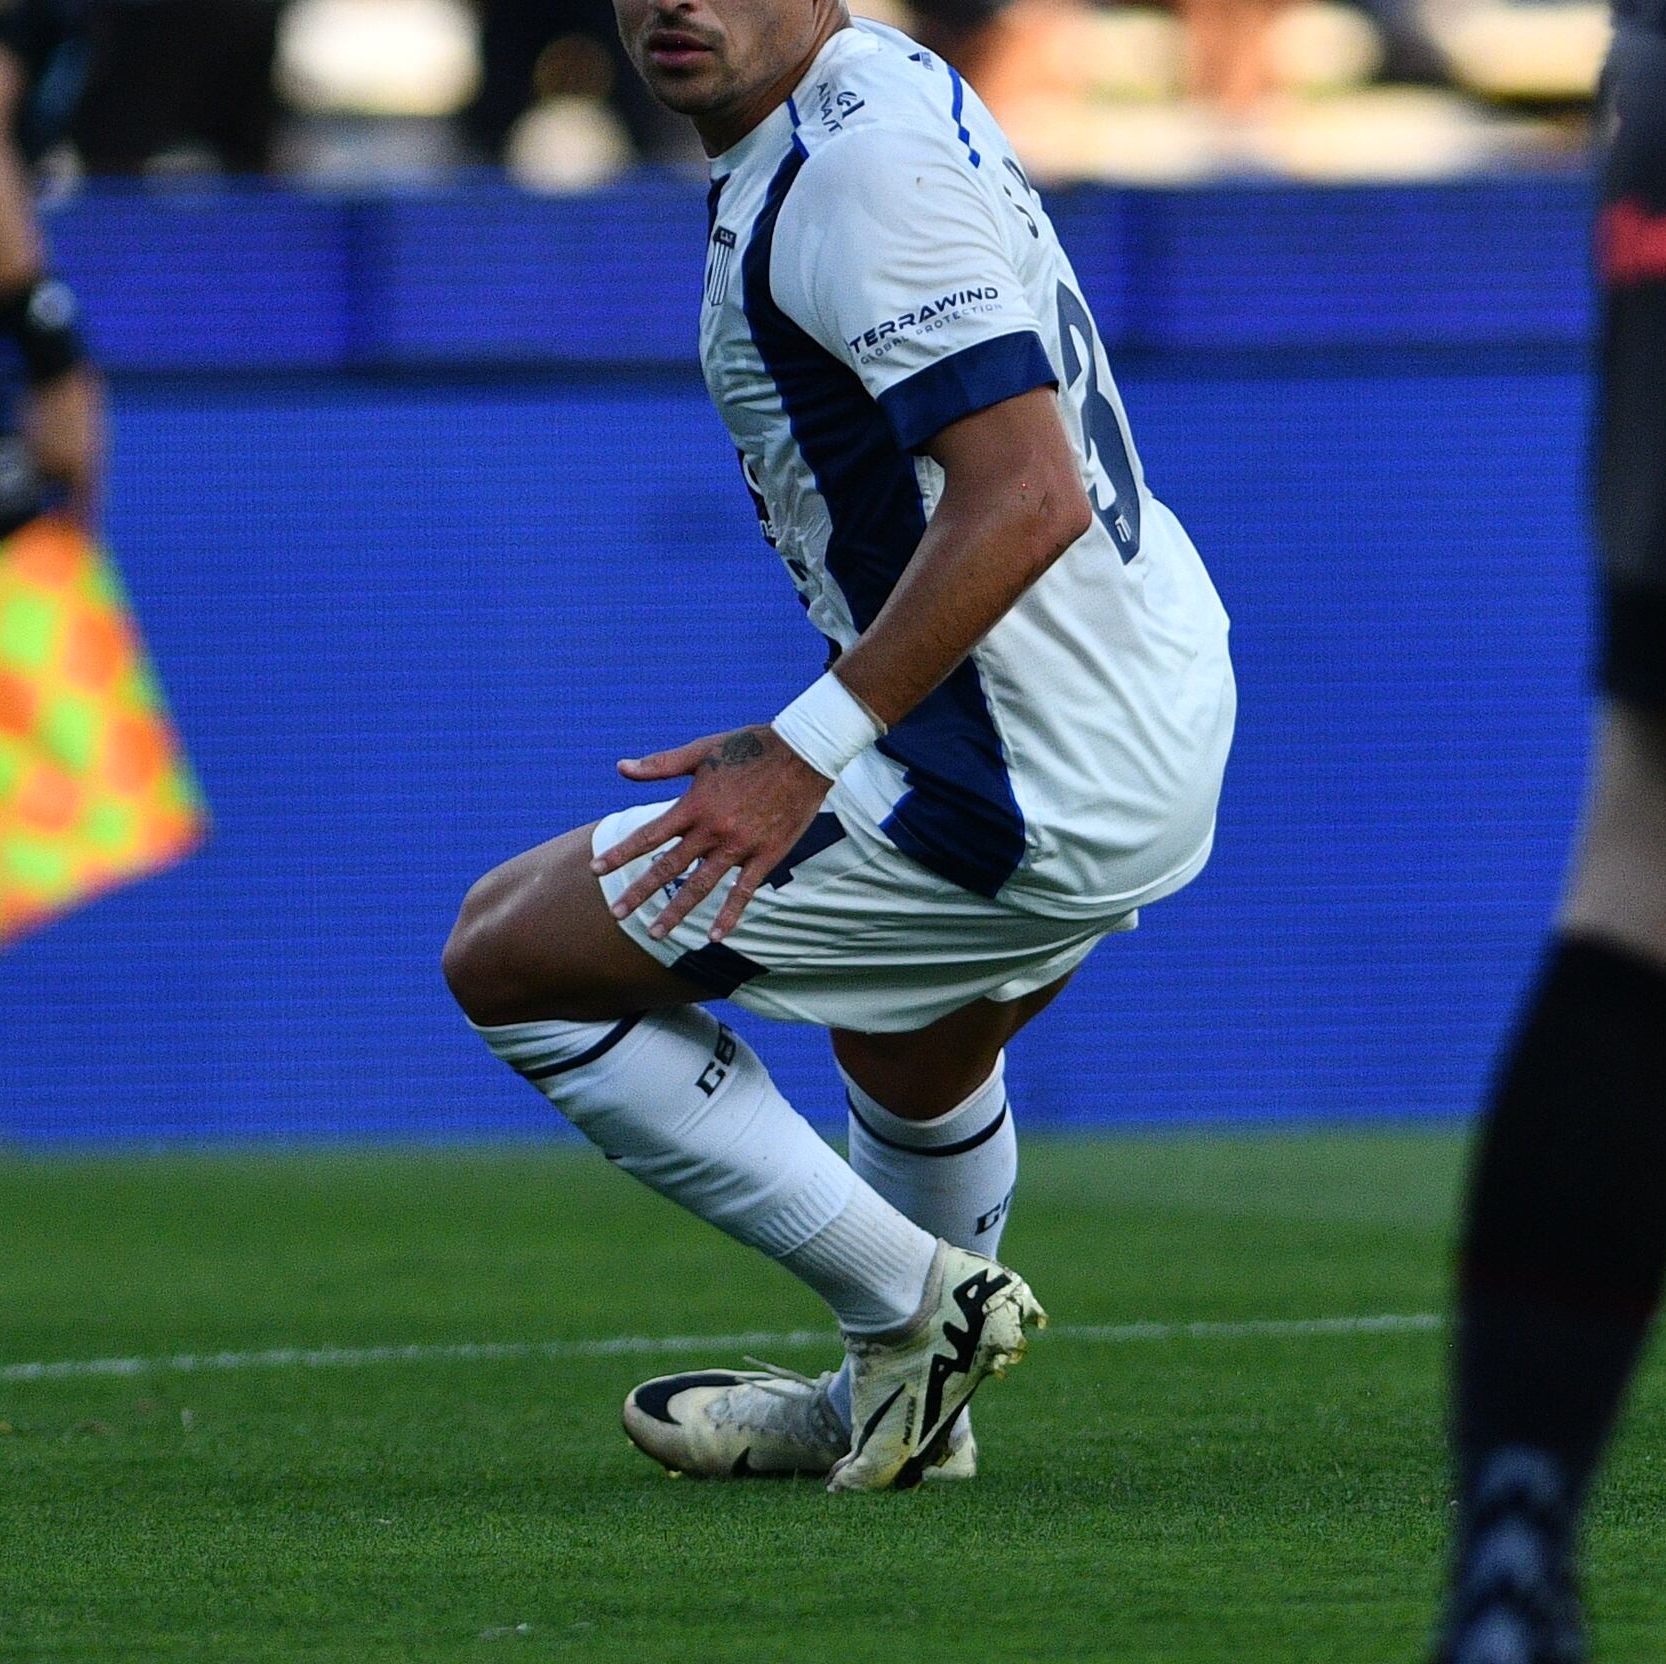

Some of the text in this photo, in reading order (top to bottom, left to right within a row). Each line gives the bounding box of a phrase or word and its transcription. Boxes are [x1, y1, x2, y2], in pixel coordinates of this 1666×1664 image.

[849, 286, 999, 354] TERRAWIND
[860, 302, 1004, 365] GLOBAL PROTECTION
